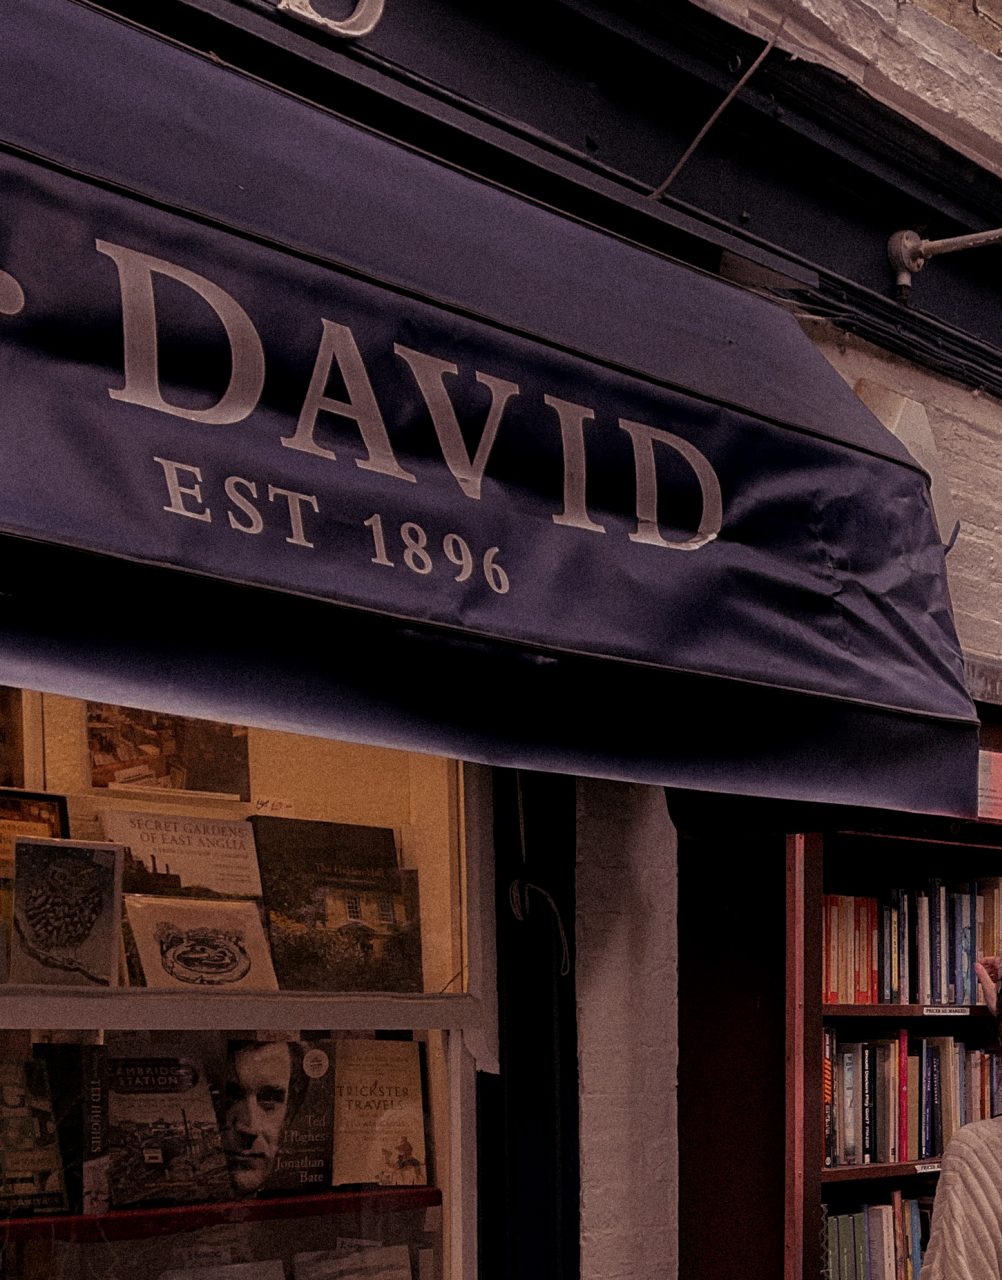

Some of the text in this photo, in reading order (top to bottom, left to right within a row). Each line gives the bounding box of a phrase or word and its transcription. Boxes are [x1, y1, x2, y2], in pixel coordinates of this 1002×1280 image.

[95, 237, 724, 551] DAVID
[153, 455, 511, 595] EST 1896
[129, 818, 248, 838] SECRET GARDENS
[139, 832, 247, 851] OF EAST ANGLIA
[119, 1076, 179, 1087] STATION
[337, 1080, 409, 1098] TRICKSTER
[275, 1156, 324, 1172] Jonathan
[299, 1171, 324, 1183] Bate
